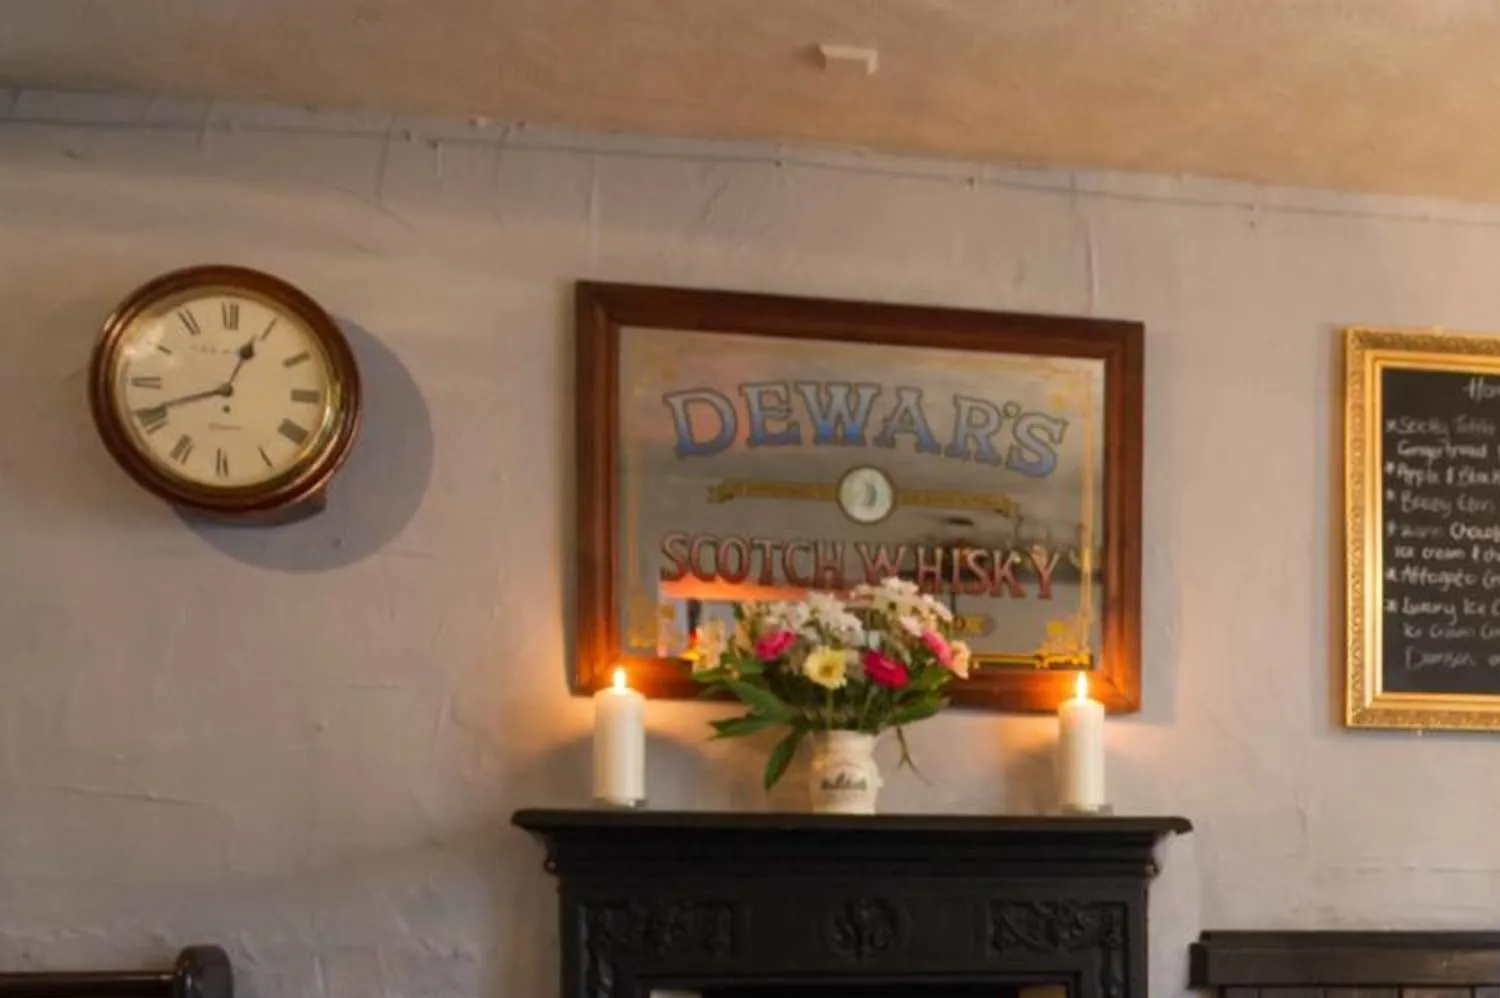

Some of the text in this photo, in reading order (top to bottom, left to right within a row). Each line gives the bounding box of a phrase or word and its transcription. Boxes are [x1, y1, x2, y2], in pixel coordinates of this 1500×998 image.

[663, 379, 1070, 478] DEWAR'S
[659, 530, 1062, 600] SCOTCH WHISKY
